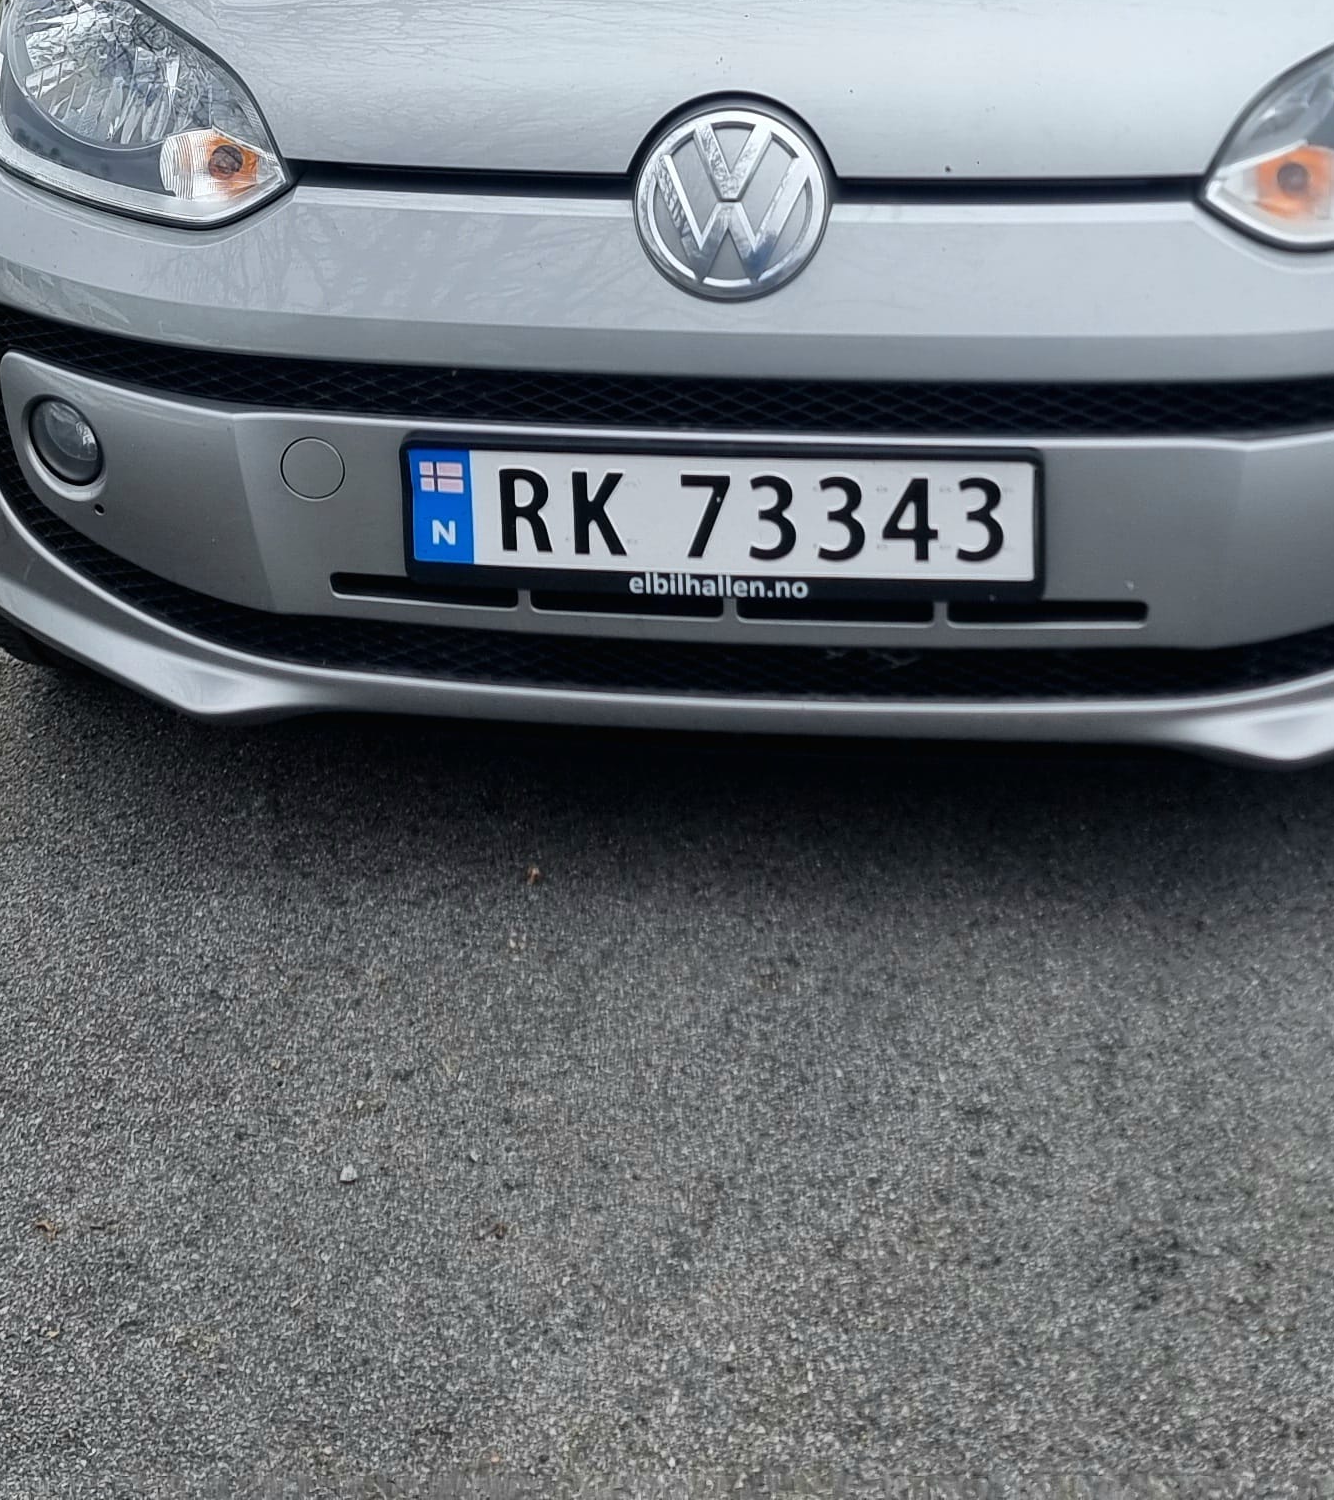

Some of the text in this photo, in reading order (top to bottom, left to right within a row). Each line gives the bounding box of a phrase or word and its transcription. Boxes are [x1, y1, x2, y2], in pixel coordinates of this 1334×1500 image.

[498, 467, 1005, 563] RK 73343
[431, 519, 457, 546] N
[628, 572, 809, 599] elbilhallen.no
